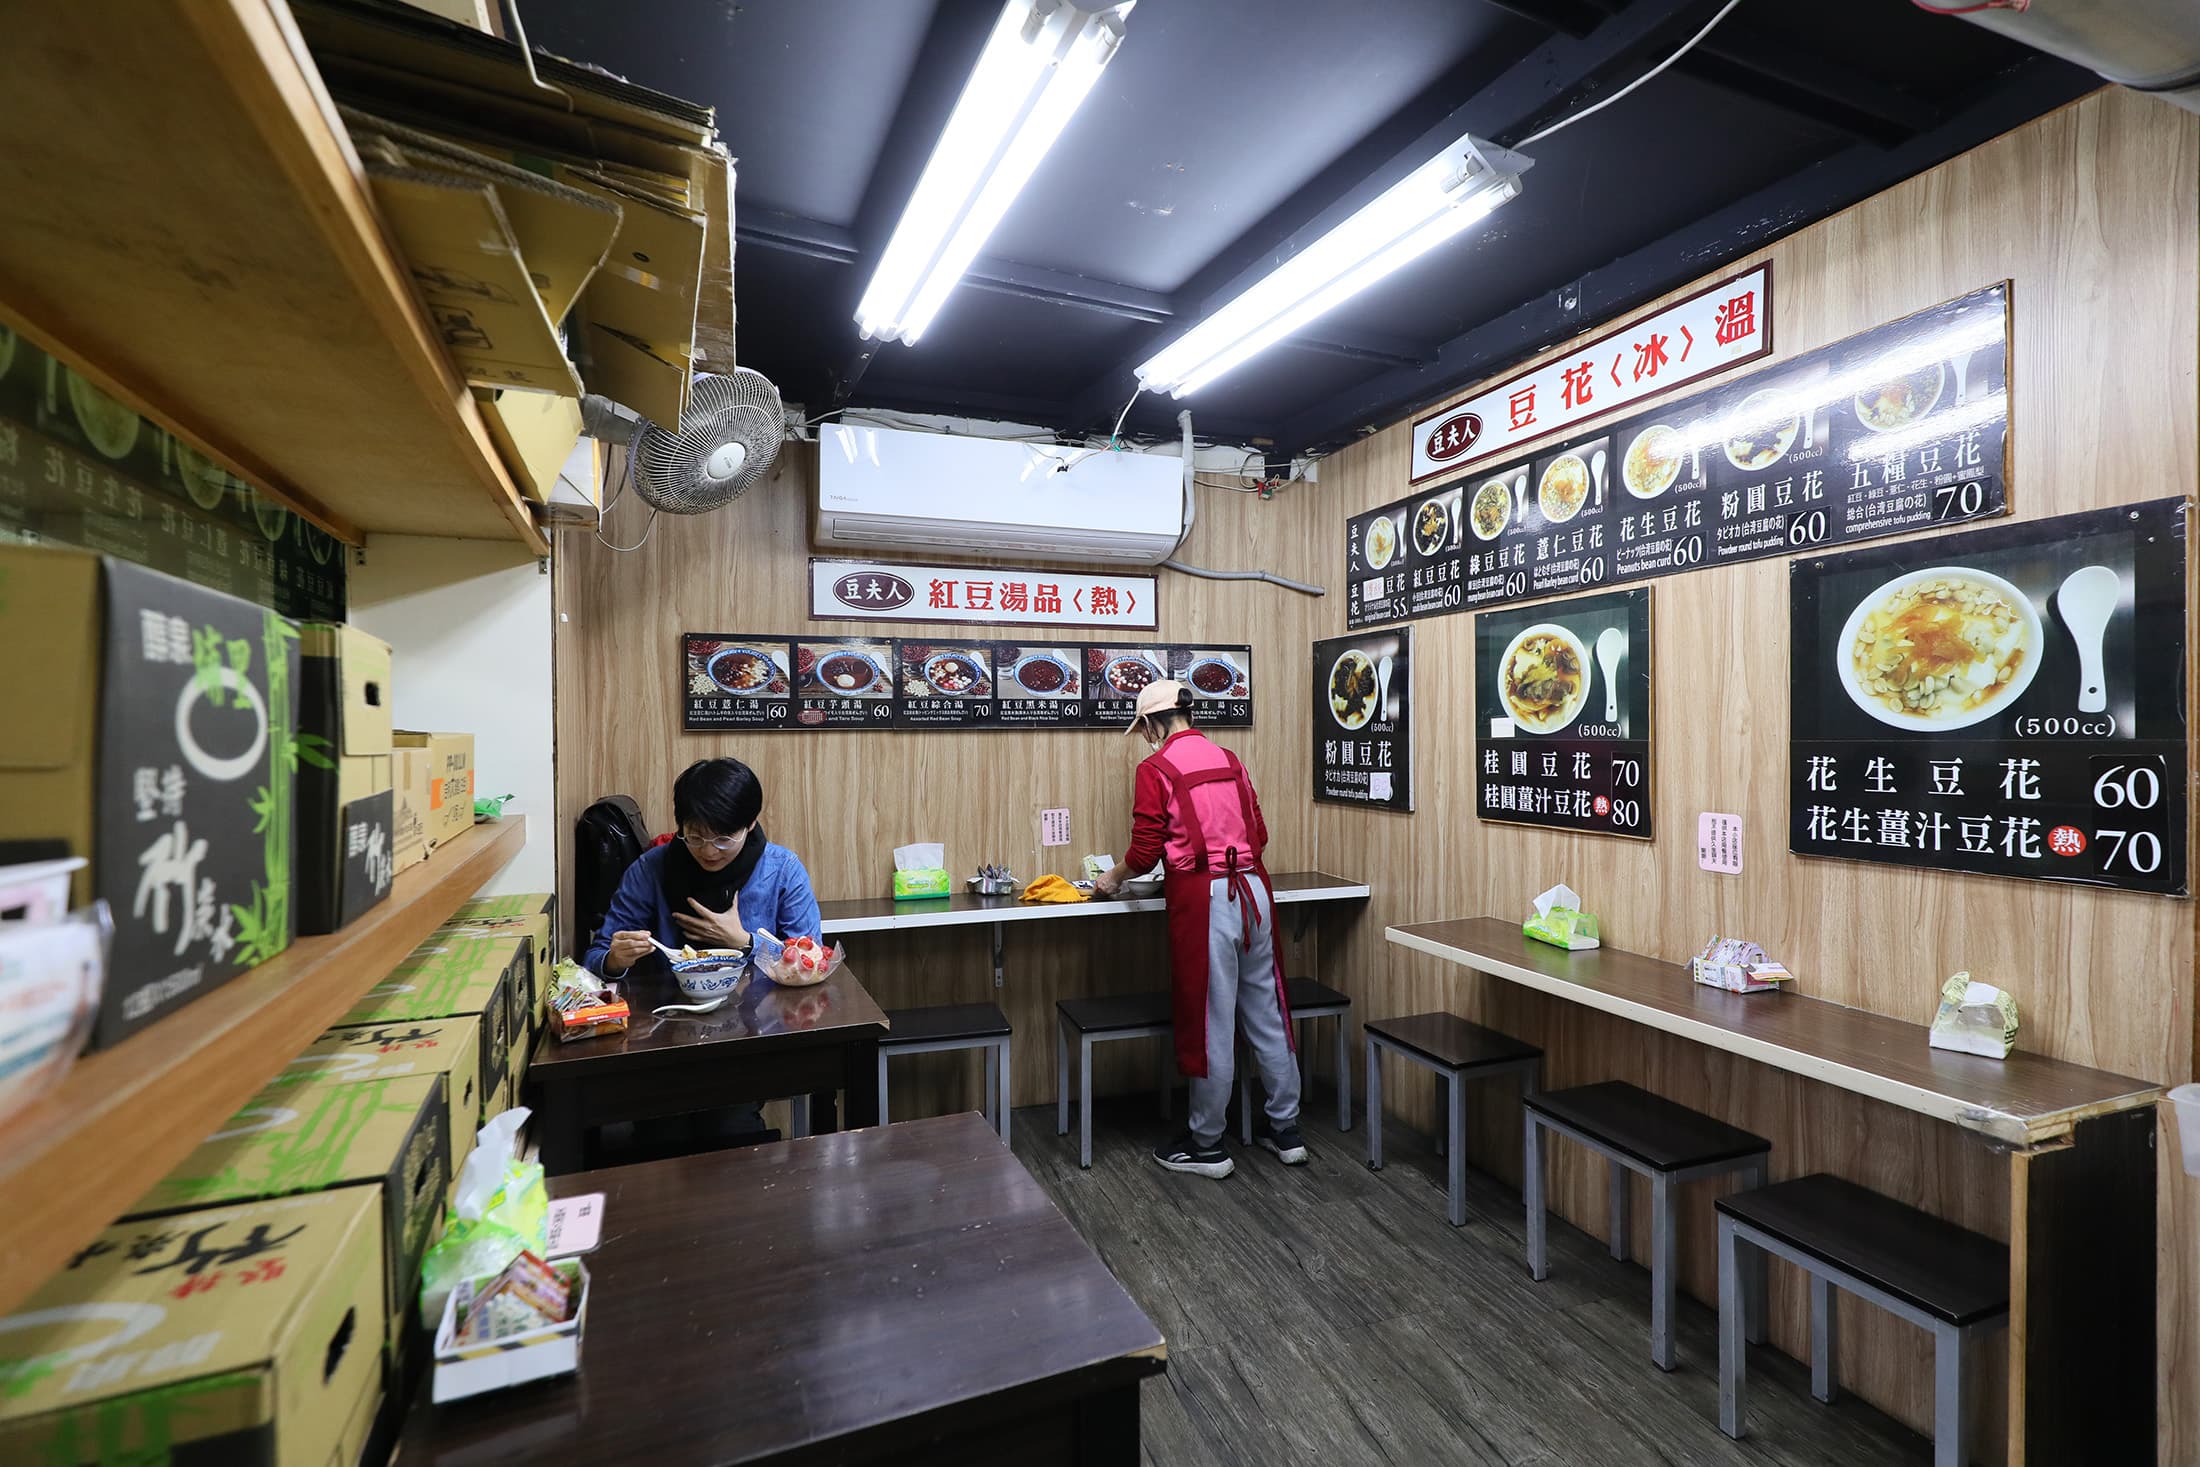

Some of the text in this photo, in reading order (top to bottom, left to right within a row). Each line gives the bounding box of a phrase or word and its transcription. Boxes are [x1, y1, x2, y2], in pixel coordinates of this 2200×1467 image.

[1432, 420, 1476, 455] 豆夫人
[1789, 447, 1823, 463] (500cc)
[1850, 430, 1982, 490] 五種豆花
[1721, 470, 1823, 520] 粉圓豆花
[1935, 482, 1983, 519] 70
[1619, 500, 1701, 542] 花生豆花
[1789, 511, 1826, 545] 60
[1845, 516, 1892, 534] comprehensive
[1907, 511, 1931, 525] pudding
[1350, 525, 1360, 572] 豆夫人
[1536, 524, 1603, 560] 薏仁豆花
[1673, 535, 1702, 566] 60
[1413, 559, 1460, 588] 紅豆豆花
[1469, 543, 1525, 575] 綠豆豆花
[1580, 556, 1604, 584] 60
[1641, 558, 1656, 571] bean
[1657, 553, 1671, 567] curd
[843, 578, 1137, 616] 豆夫人 紅豆湯品〈熱〉
[1444, 584, 1461, 607] 60
[1506, 571, 1526, 596] 60
[770, 704, 788, 718] 60
[873, 704, 890, 717] 60
[974, 704, 989, 716] 70
[1064, 704, 1079, 716] 60
[1232, 705, 1245, 717] 55
[1371, 722, 1394, 732] (500cc)
[1578, 723, 1622, 738] (500cc)
[2014, 714, 2117, 738] (500cc)
[1325, 740, 1392, 767] 粉圓豆花
[1484, 749, 1592, 780] 桂圓豆花
[1612, 759, 1640, 787] 70
[1806, 756, 2042, 800] 花生豆花
[2093, 764, 2160, 810] 60
[1484, 783, 1608, 818] 桂圓薑汁豆花 熱
[1612, 799, 1640, 827] 80
[1806, 805, 2082, 858] 花生薑汁豆花 熱
[2094, 829, 2162, 873] 70
